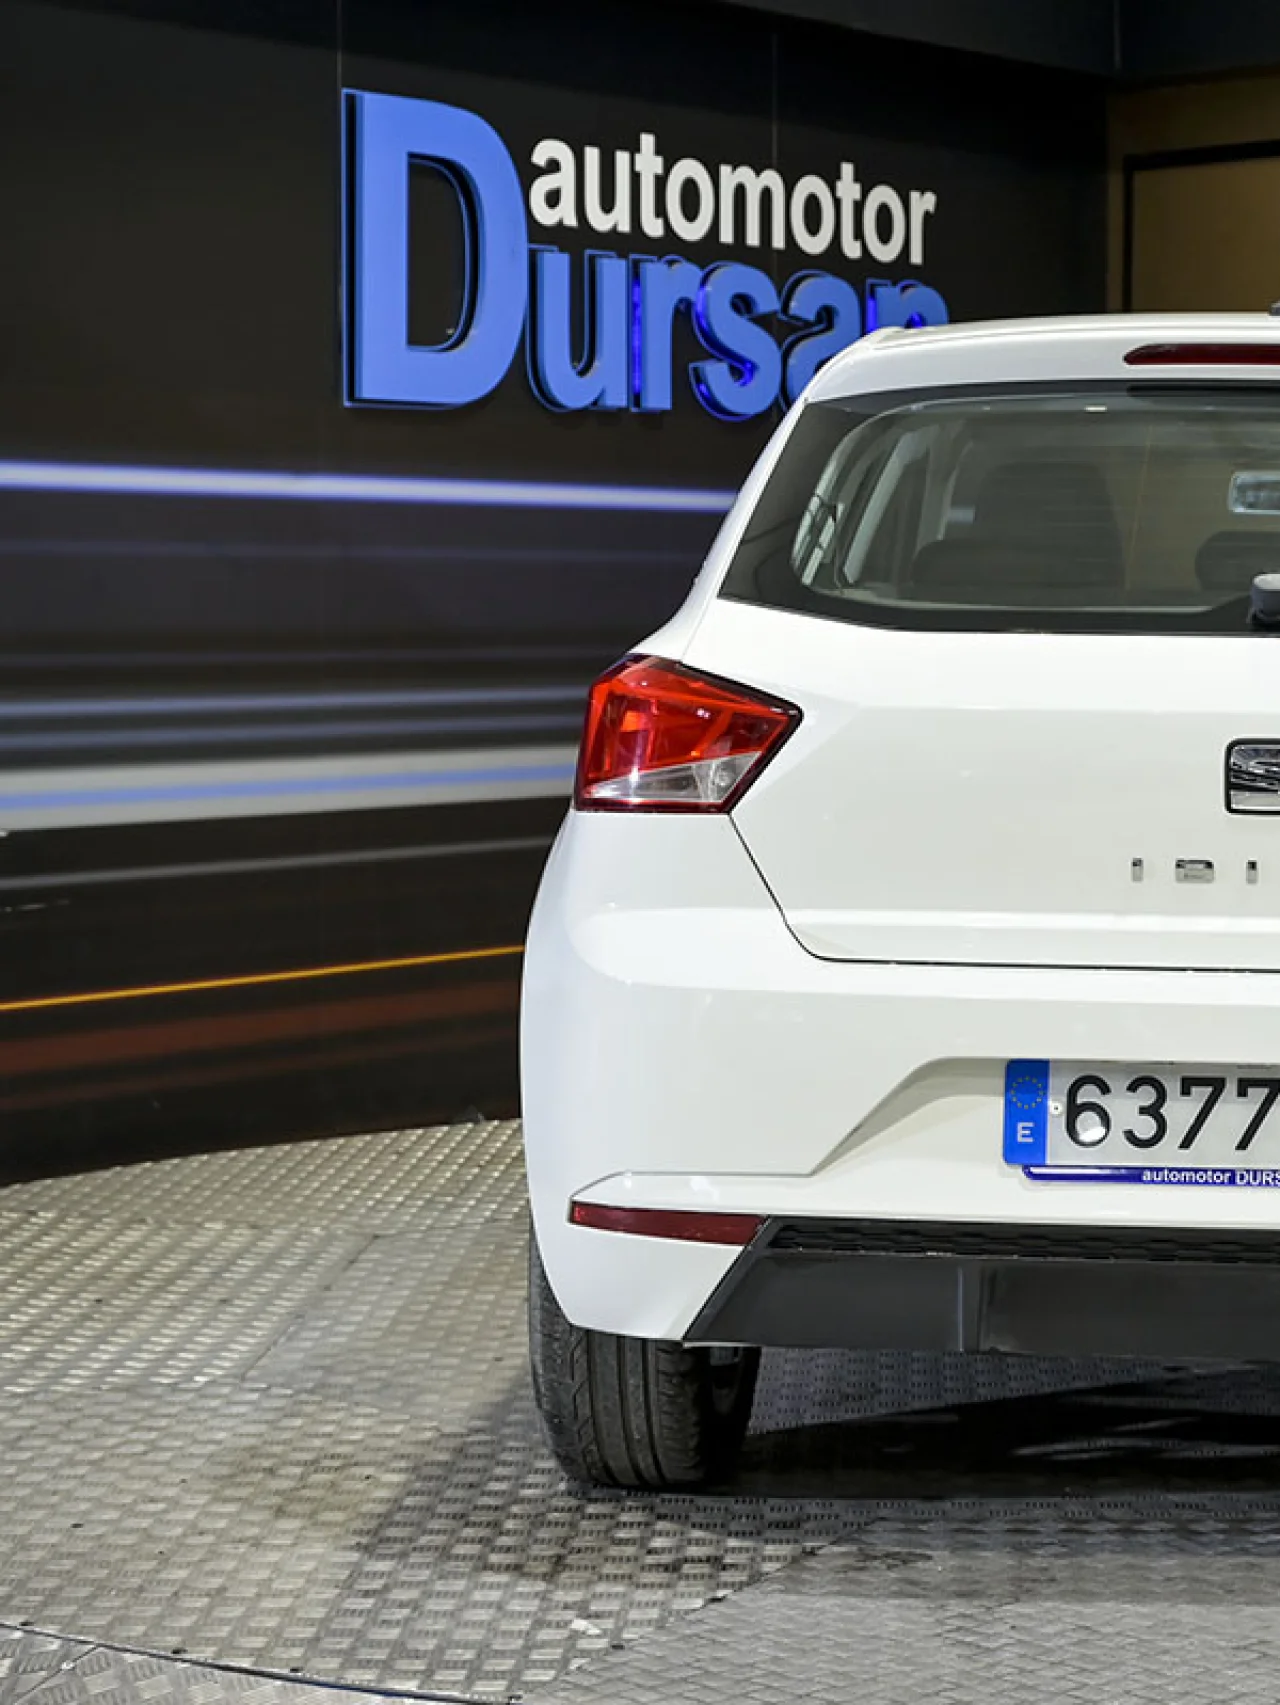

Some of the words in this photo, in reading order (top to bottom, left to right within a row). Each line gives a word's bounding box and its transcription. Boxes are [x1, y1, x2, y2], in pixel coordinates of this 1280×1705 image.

[528, 131, 938, 265] automotor
[1016, 1122, 1034, 1143] E
[1141, 1167, 1232, 1185] automotor
